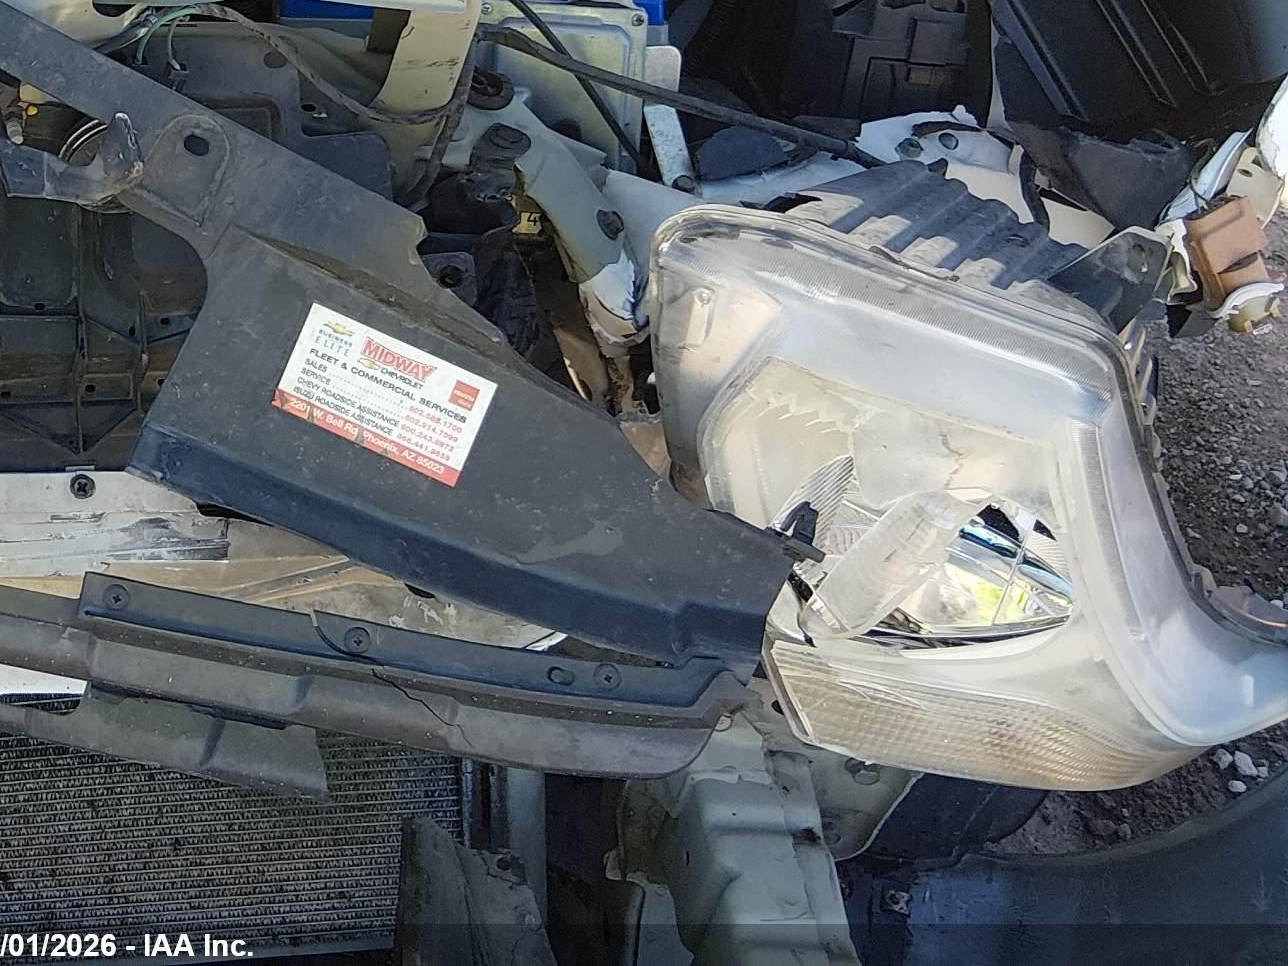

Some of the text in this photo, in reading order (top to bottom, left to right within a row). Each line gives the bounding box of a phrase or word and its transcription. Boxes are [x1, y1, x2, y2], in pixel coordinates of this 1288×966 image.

[304, 357, 328, 373] SALES
[314, 335, 350, 357] ELITE
[362, 338, 436, 382] MIDWAY
[300, 366, 331, 386] SERVICE
[308, 347, 339, 366] FLEET
[340, 361, 349, 370] &
[349, 365, 417, 401] COMMERCIAL
[418, 396, 467, 424] SERVICES
[379, 366, 423, 391] CHEVROLET
[292, 385, 314, 400] ISUZU
[314, 395, 350, 416] ROADSIDE
[350, 411, 393, 436] ASSISTANCE
[296, 376, 320, 391] CHEVY
[320, 386, 356, 408] ROADSIDE
[356, 403, 400, 428] ASSISTANCE
[288, 397, 311, 414] 2201
[324, 413, 343, 428] Bell
[397, 447, 416, 461] AZ
[414, 455, 445, 475] 85023
